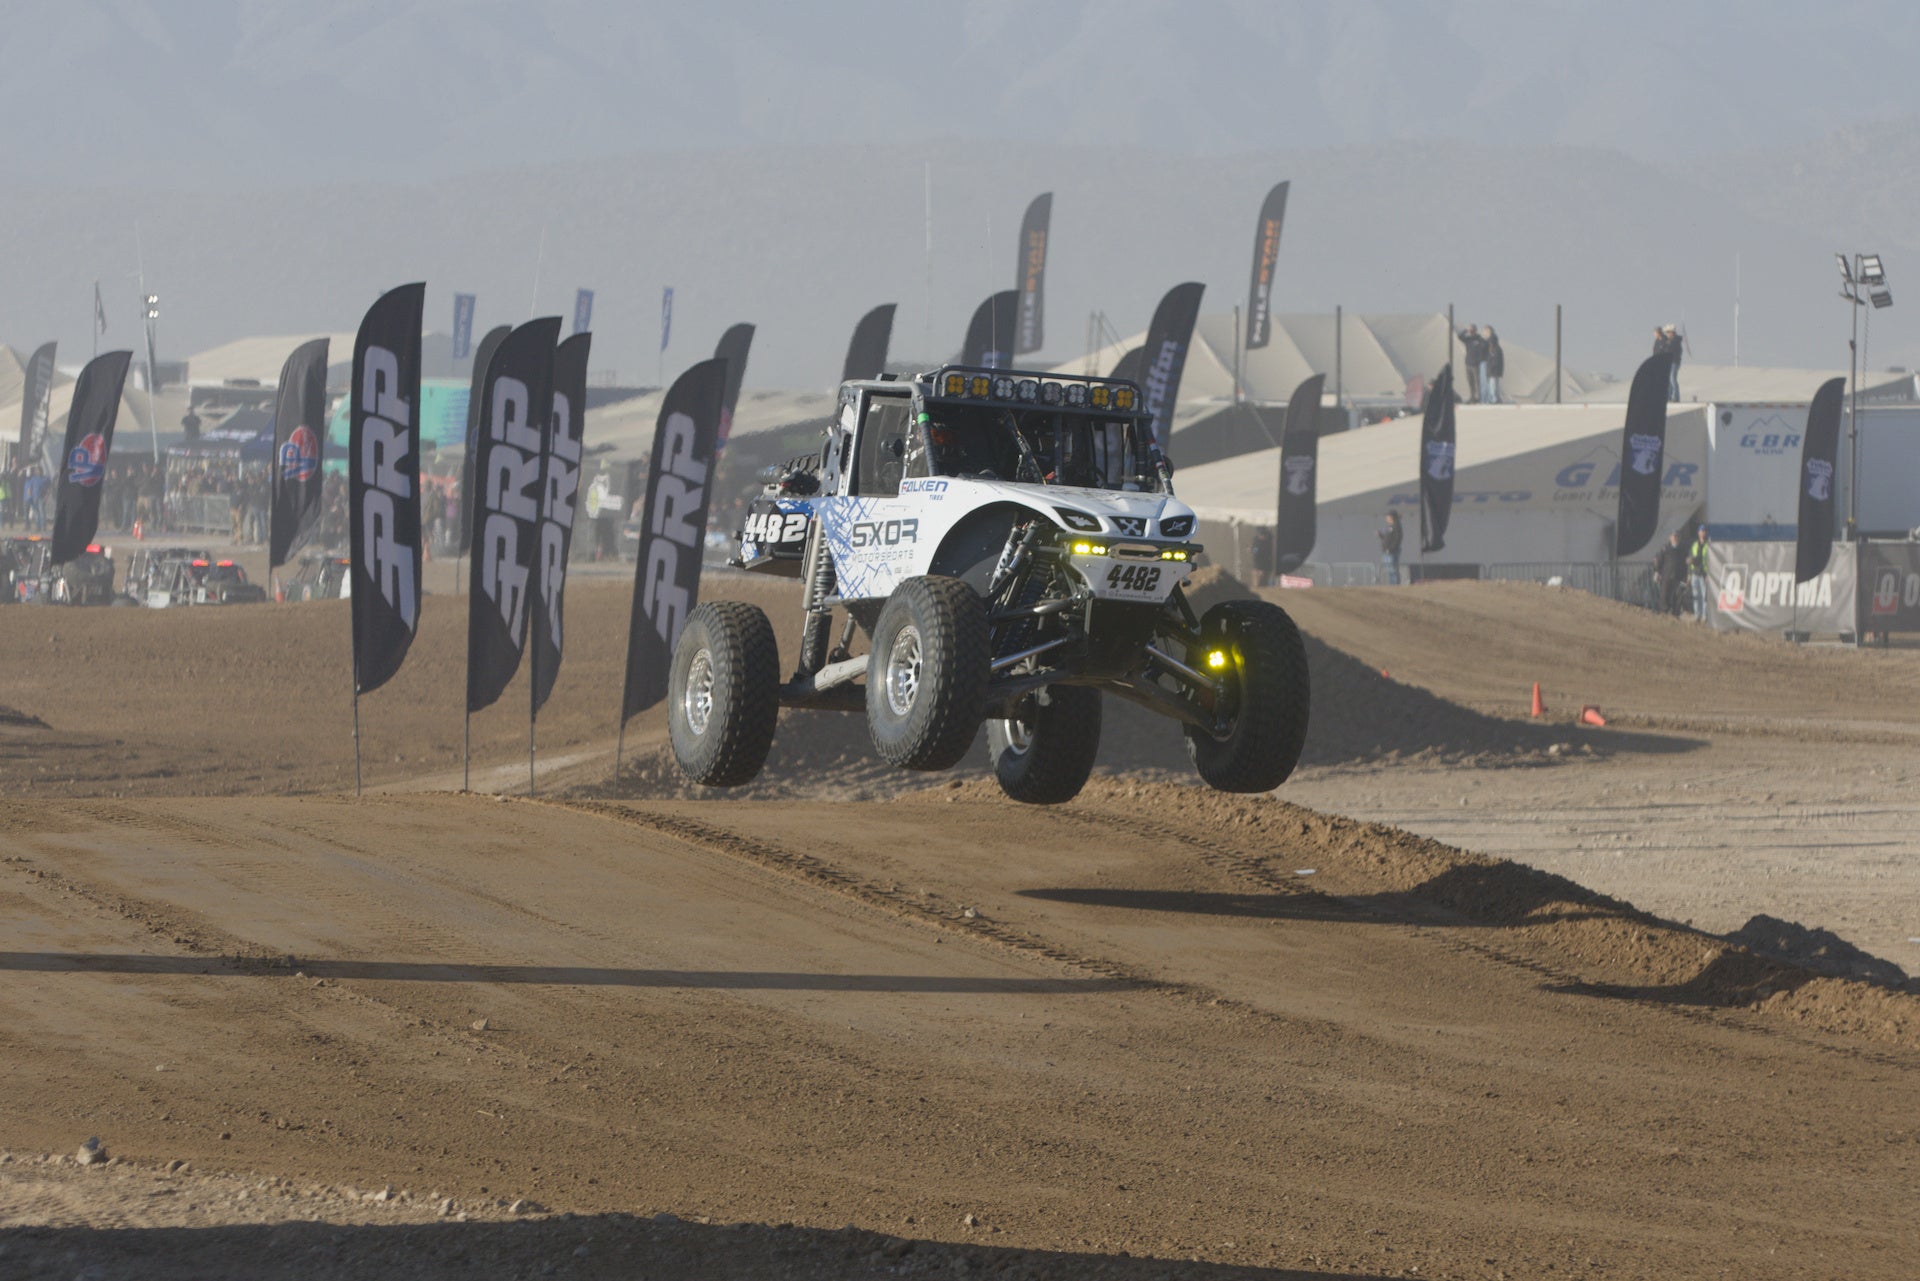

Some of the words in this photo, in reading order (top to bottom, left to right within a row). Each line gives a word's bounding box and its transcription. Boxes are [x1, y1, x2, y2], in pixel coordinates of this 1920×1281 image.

[361, 344, 416, 635] PRP
[901, 480, 949, 493] FALKEN
[482, 376, 543, 651] PRP
[744, 513, 808, 544] 4482
[852, 550, 914, 564] MOTORSPORTS
[1106, 564, 1161, 591] 4482
